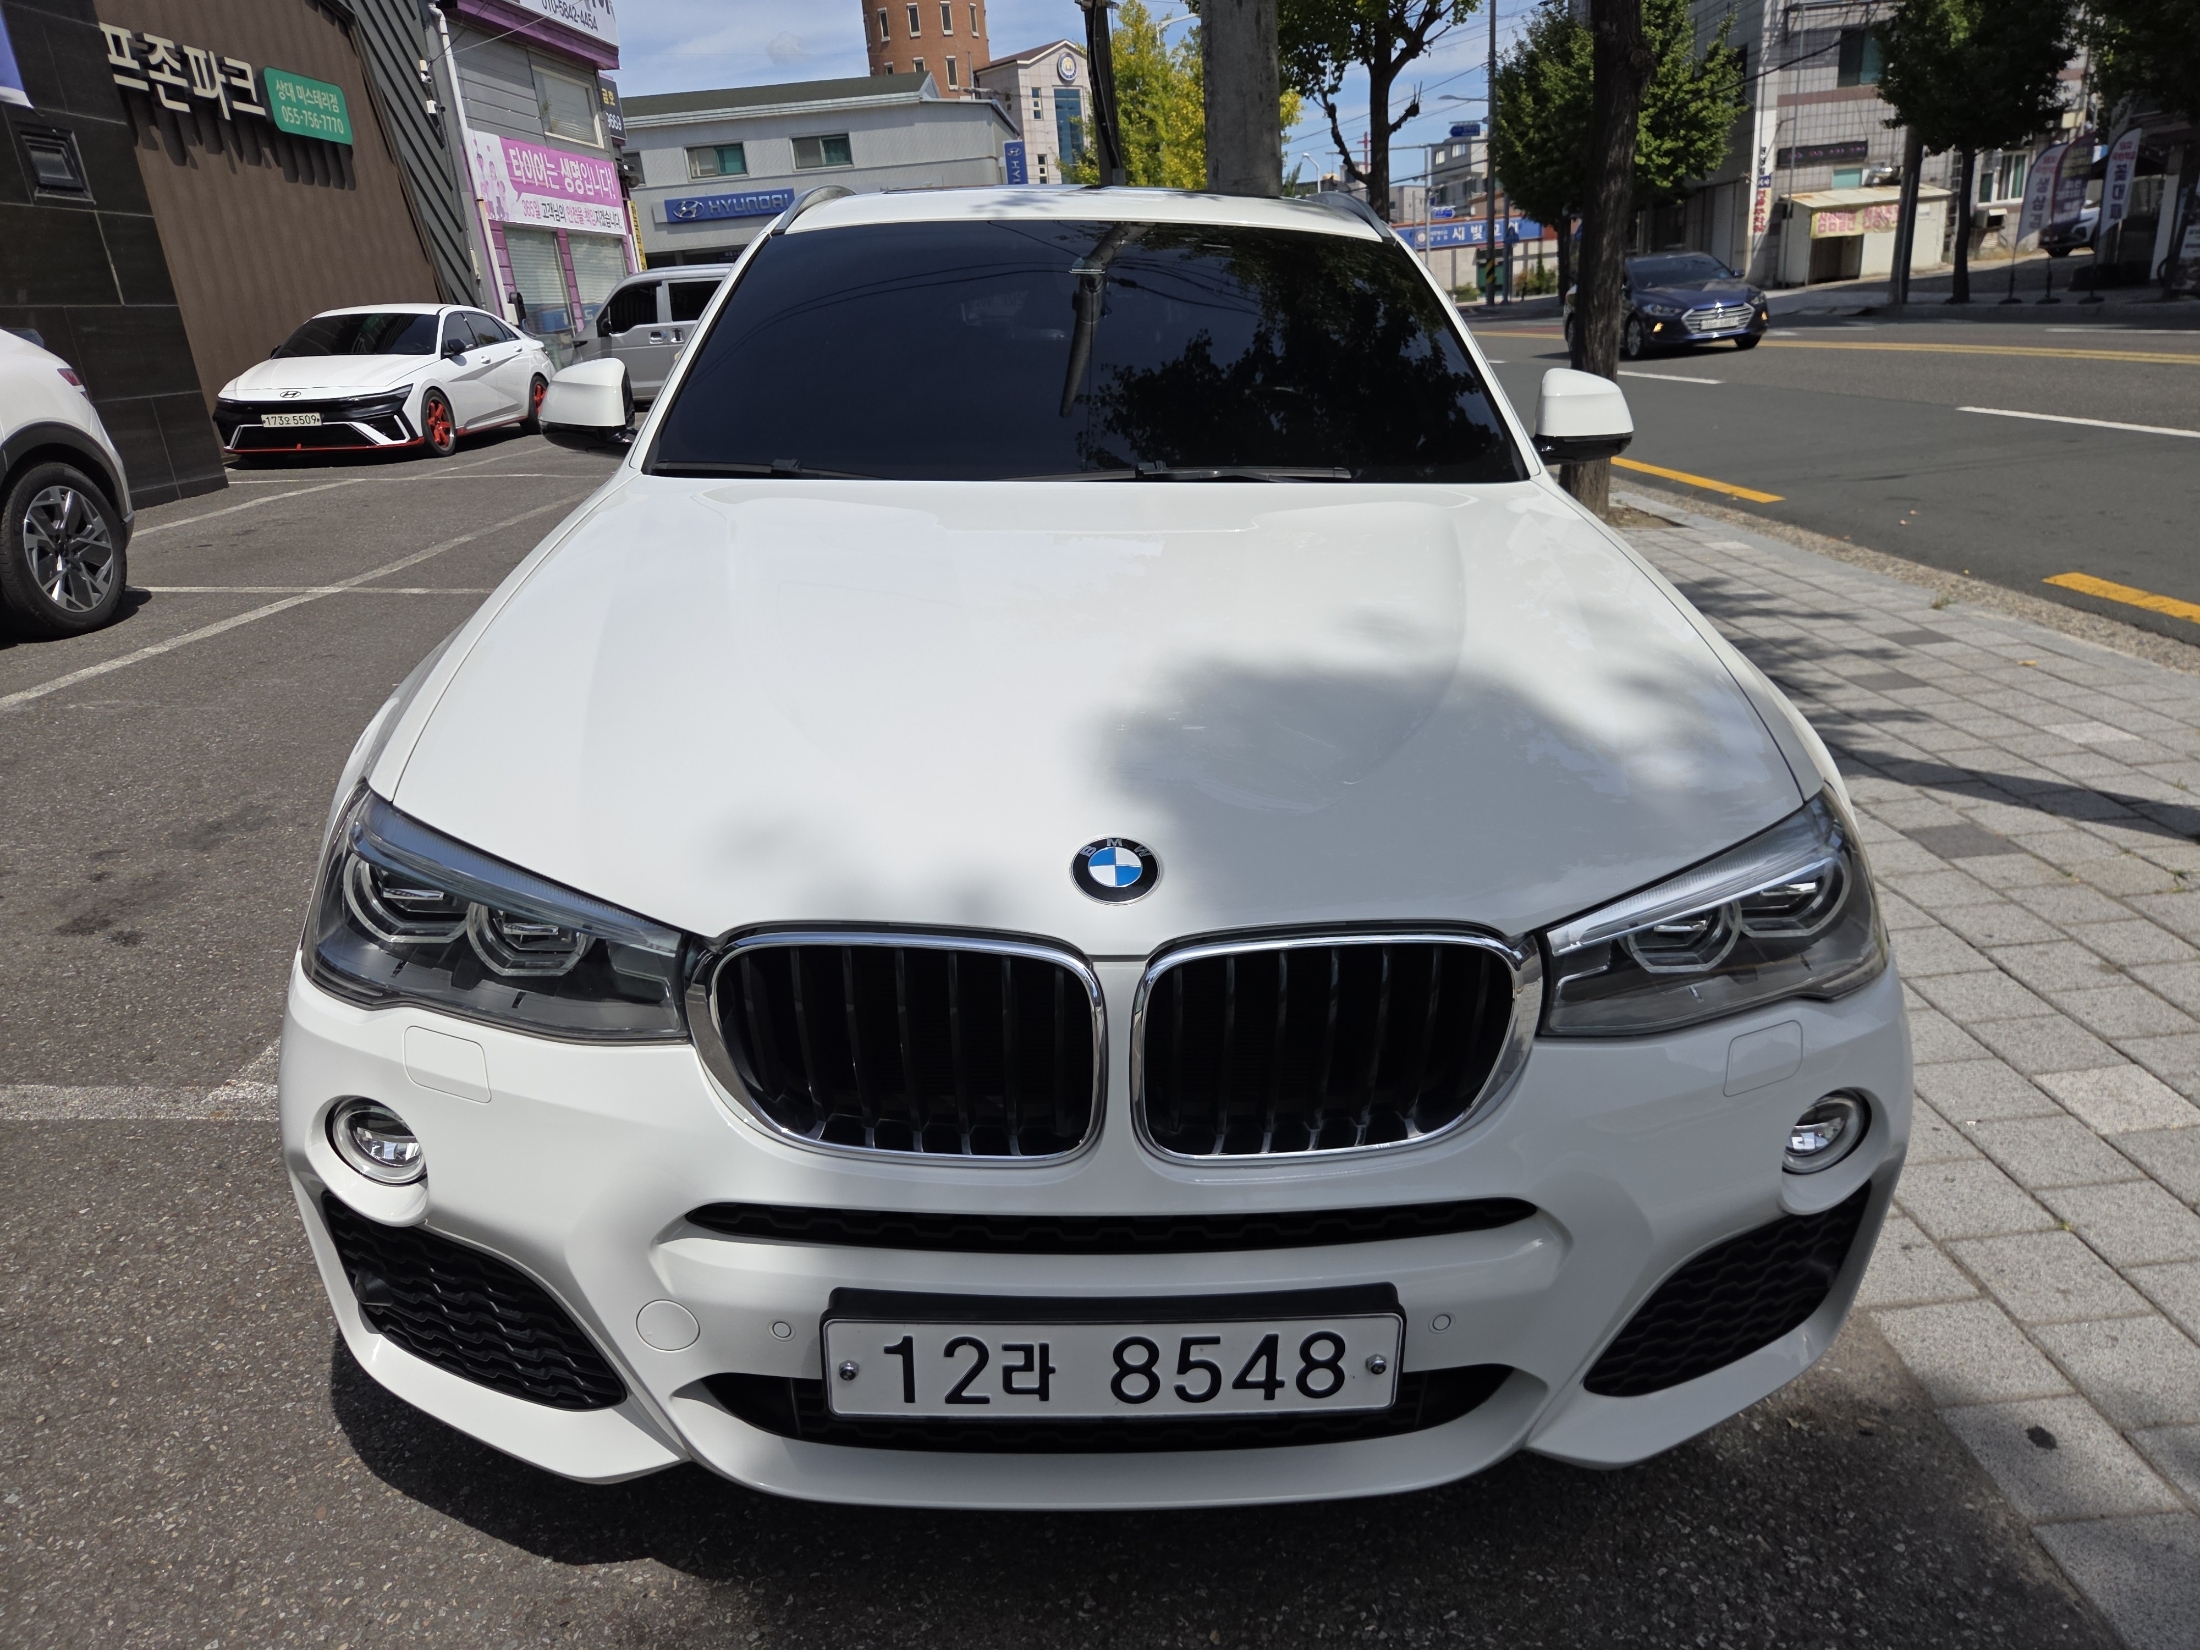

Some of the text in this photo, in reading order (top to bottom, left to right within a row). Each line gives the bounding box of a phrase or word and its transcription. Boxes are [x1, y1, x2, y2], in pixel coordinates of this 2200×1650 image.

[98, 21, 267, 121] 프존파크
[275, 79, 340, 114] 상대 미스테리점
[281, 107, 344, 134] 055-756-7770
[508, 147, 617, 200] 타이어는 생명입니다!
[521, 200, 541, 220] 365일
[541, 202, 566, 223] 고객님의
[565, 205, 584, 225] 안전을
[708, 193, 789, 214] HYUNDAI
[266, 414, 316, 426] 173오 5509
[1079, 837, 1153, 858] BMW
[882, 1330, 1349, 1405] 12라 8548
